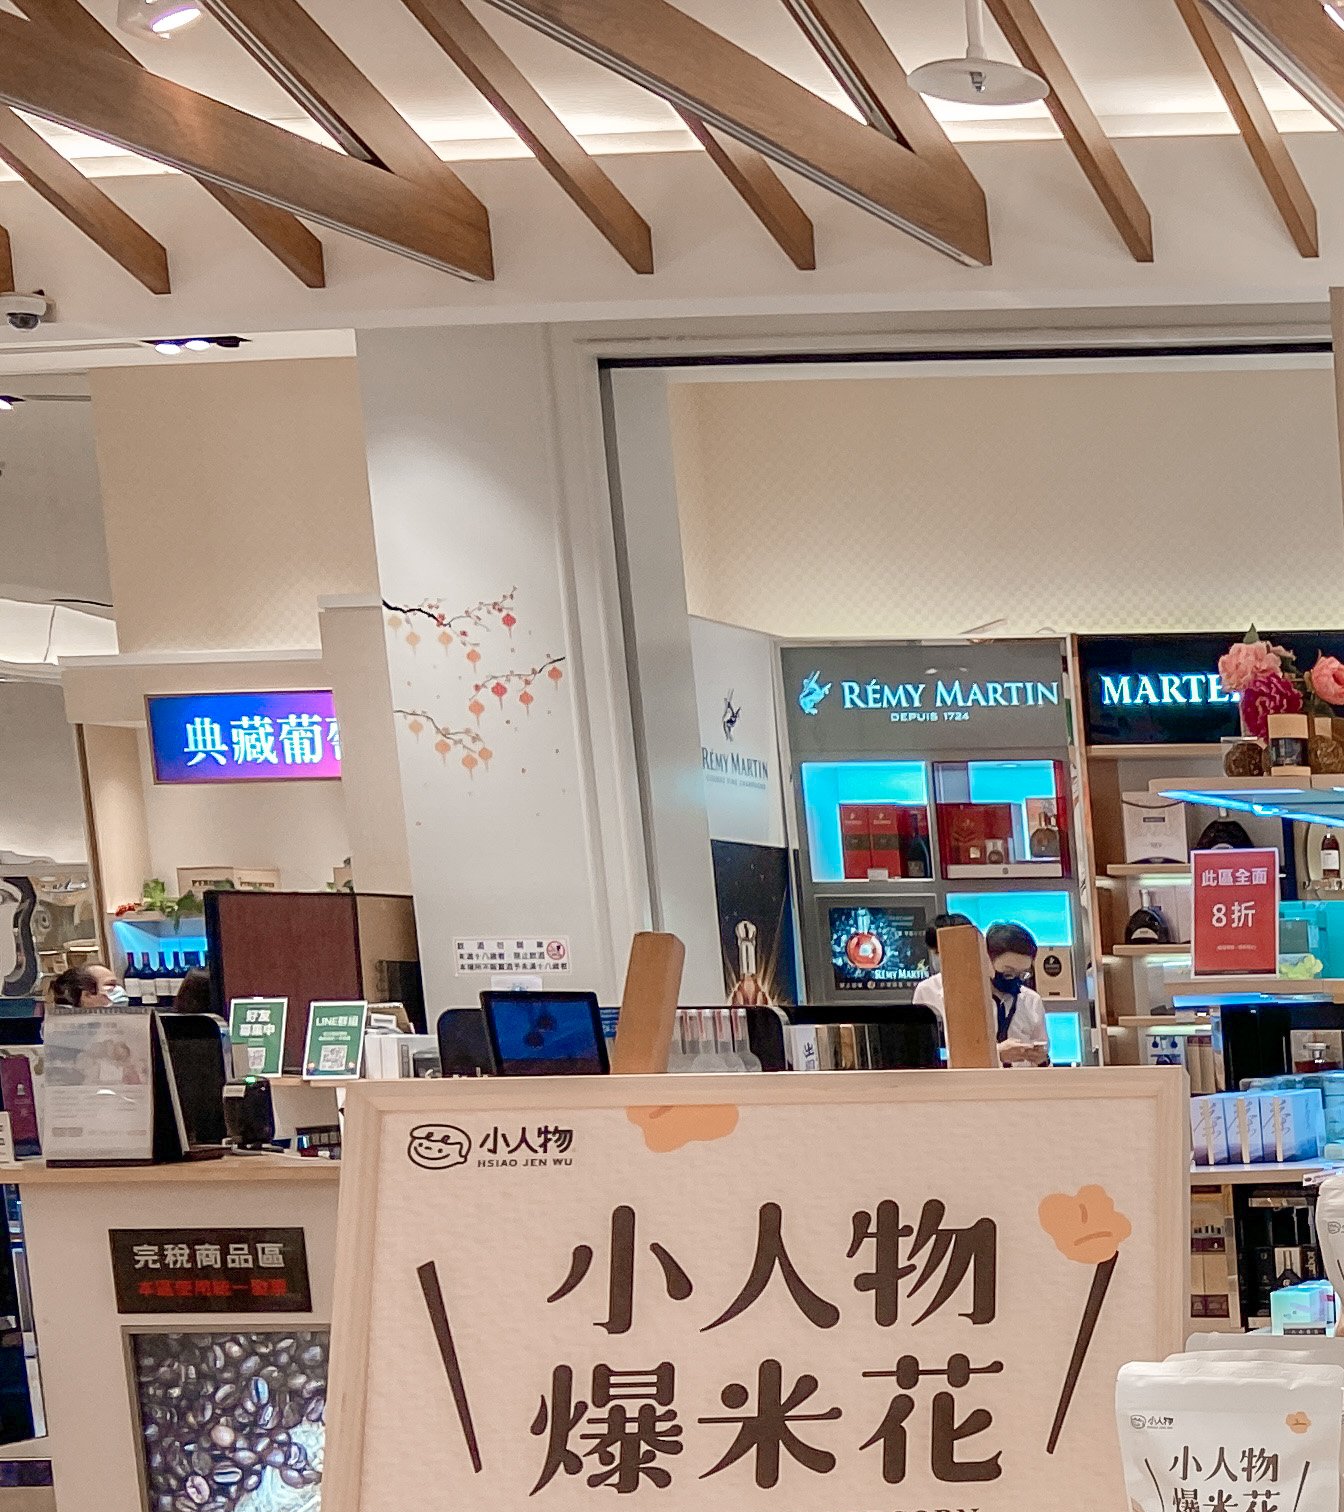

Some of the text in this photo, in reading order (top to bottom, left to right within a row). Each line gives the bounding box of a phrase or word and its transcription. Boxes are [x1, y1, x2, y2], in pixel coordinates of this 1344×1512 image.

[841, 678, 1059, 709] RÉMY MARTIN
[1102, 672, 1240, 706] MARTE
[890, 711, 970, 722] DEPUIS 1724
[731, 752, 769, 779] MARTIN
[1201, 867, 1268, 887] 此區全面
[1211, 900, 1256, 929] 8折
[479, 1124, 575, 1155] 小人物
[477, 1158, 574, 1168] HSIAO JEN WU
[132, 1242, 285, 1270] 完稅商品區
[547, 1199, 999, 1335] 小人物
[529, 1353, 1004, 1498] 爆米花
[1168, 1445, 1280, 1483] 小人物
